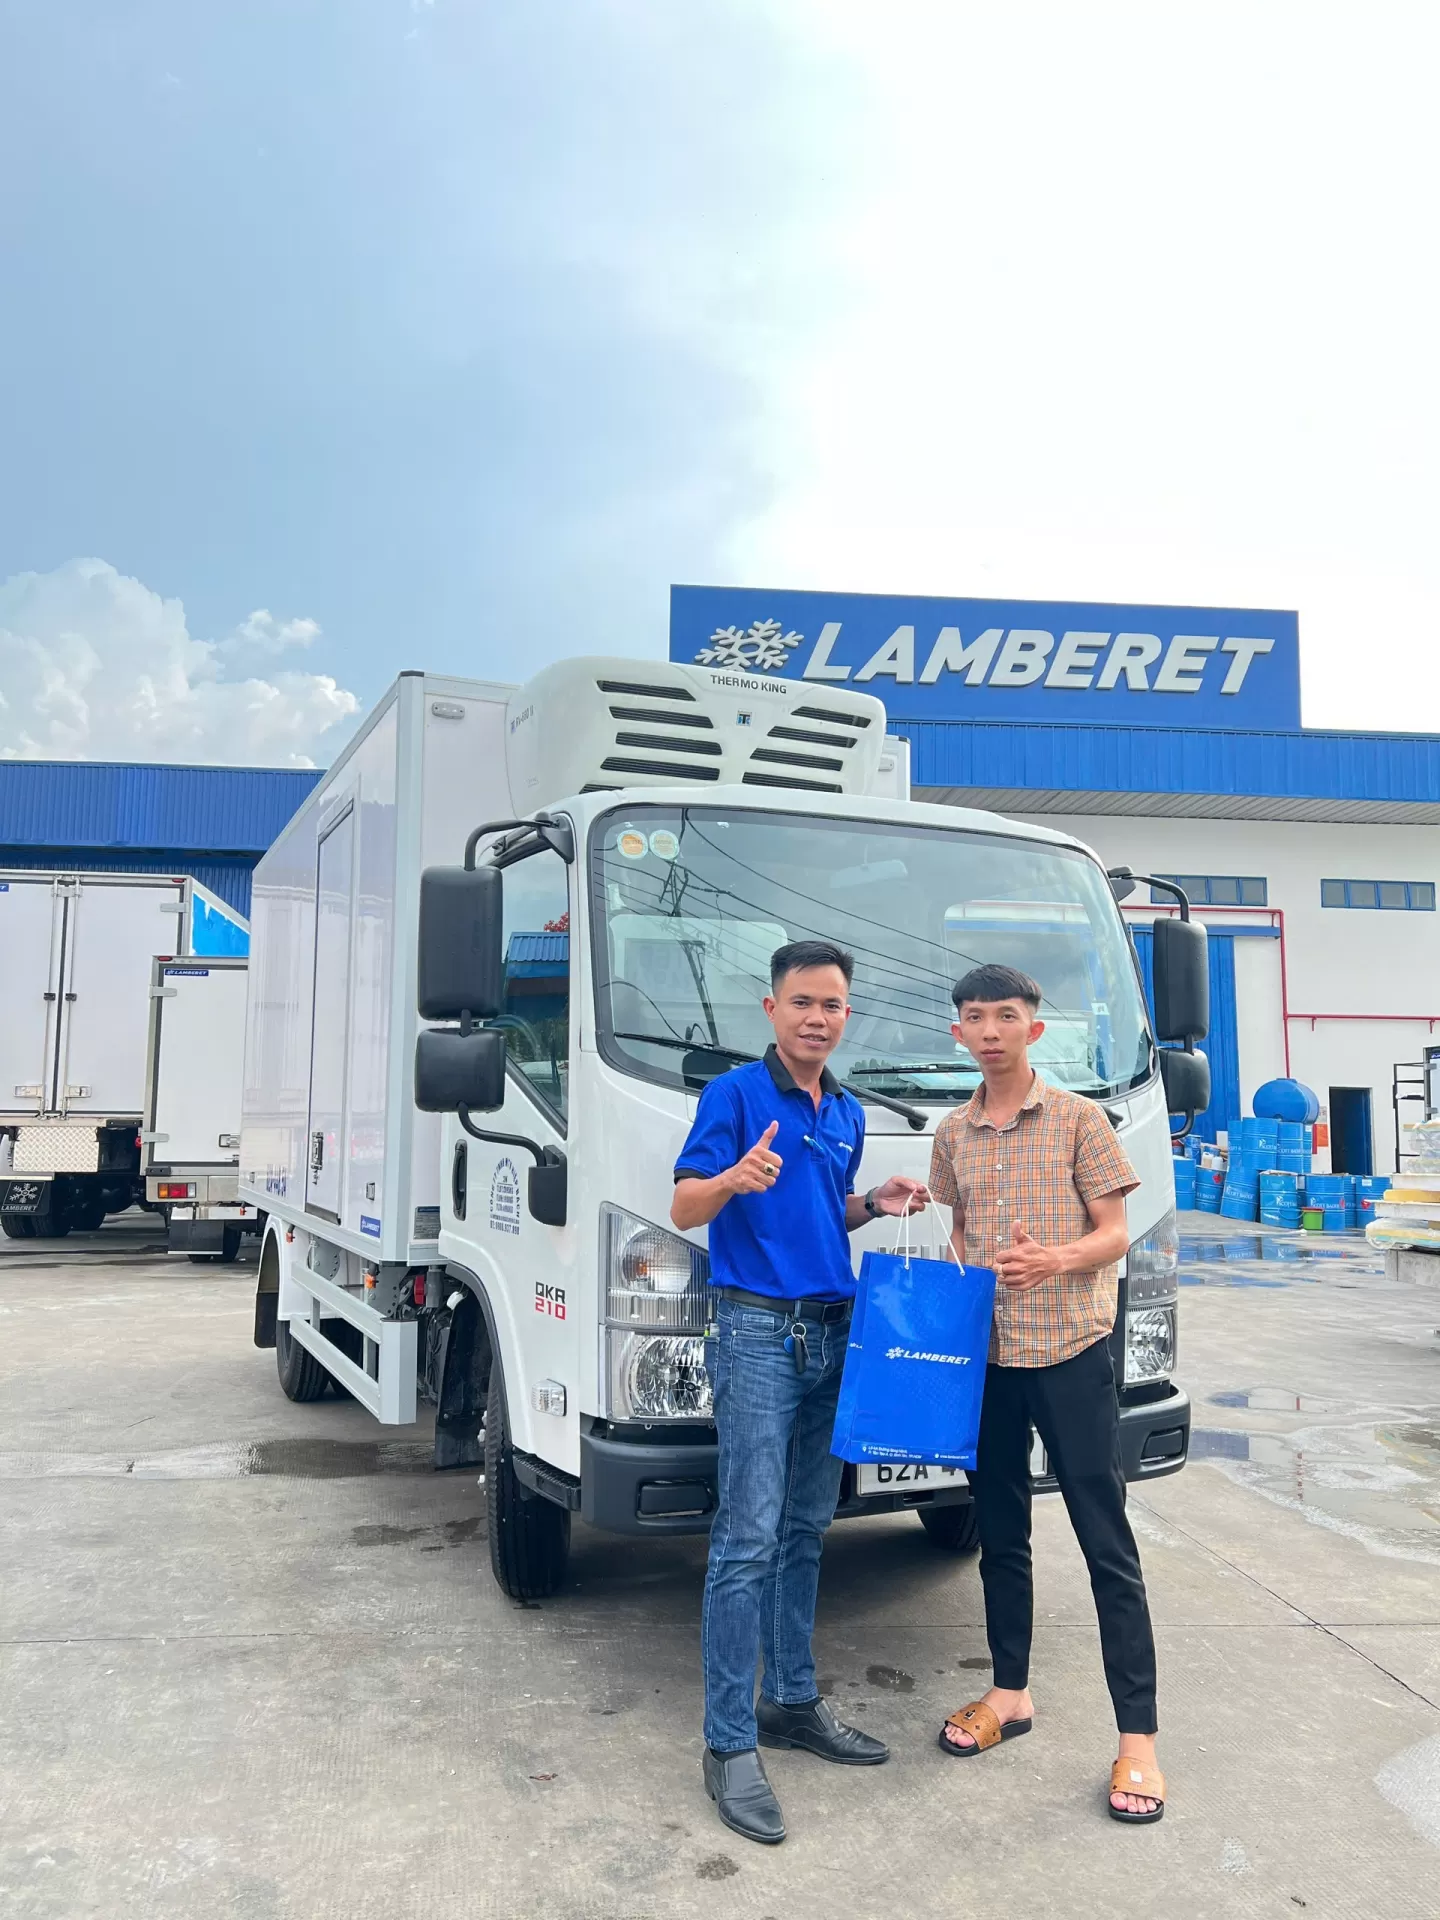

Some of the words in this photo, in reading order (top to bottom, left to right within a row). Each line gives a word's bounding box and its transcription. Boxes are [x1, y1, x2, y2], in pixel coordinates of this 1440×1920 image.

[802, 622, 1275, 693] LAMBERET
[710, 674, 759, 690] THERMO
[761, 682, 787, 694] KING
[535, 1281, 566, 1304] QKR
[535, 1296, 566, 1320] 210
[903, 1350, 971, 1365] LAMBERET
